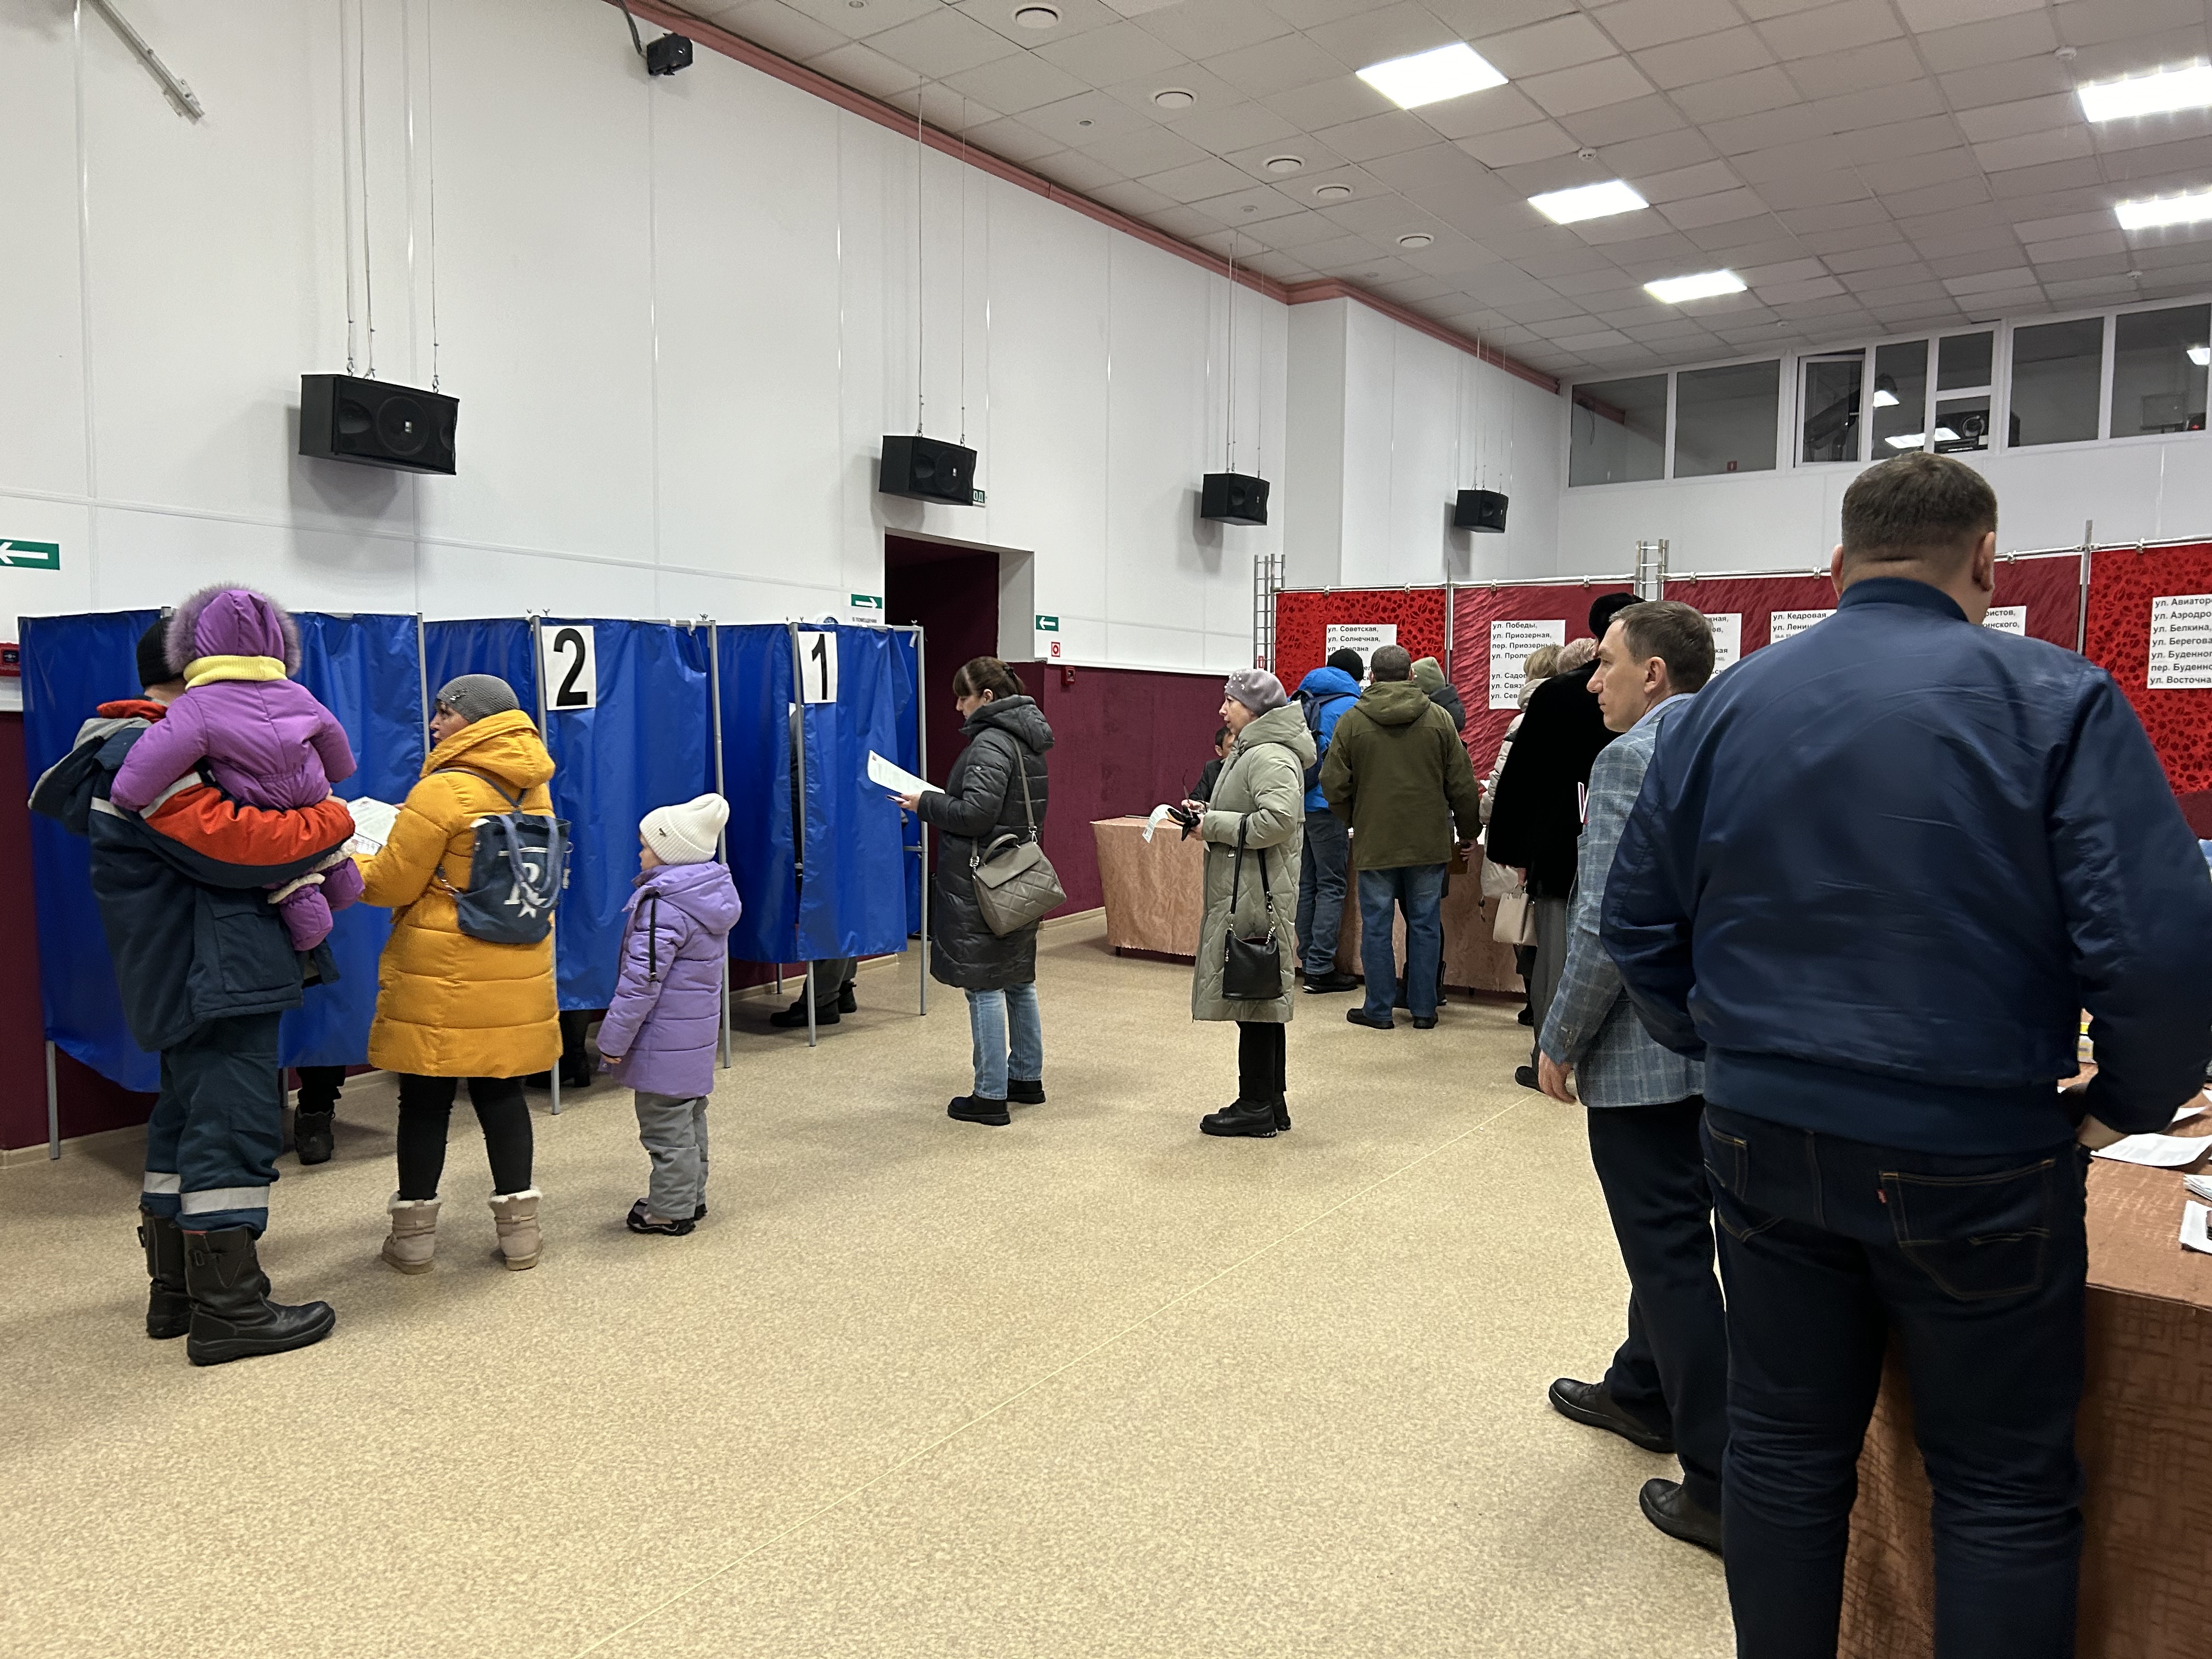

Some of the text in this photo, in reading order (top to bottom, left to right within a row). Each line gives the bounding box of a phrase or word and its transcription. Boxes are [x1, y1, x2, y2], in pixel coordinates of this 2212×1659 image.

[973, 490, 984, 503] ОД
[2155, 600, 2169, 608] ул.
[2154, 613, 2168, 622] ул.
[2153, 626, 2167, 634] ул.
[2152, 639, 2166, 647] ул.
[554, 628, 588, 707] 2
[811, 634, 828, 700] 1
[2150, 677, 2164, 685] ул.
